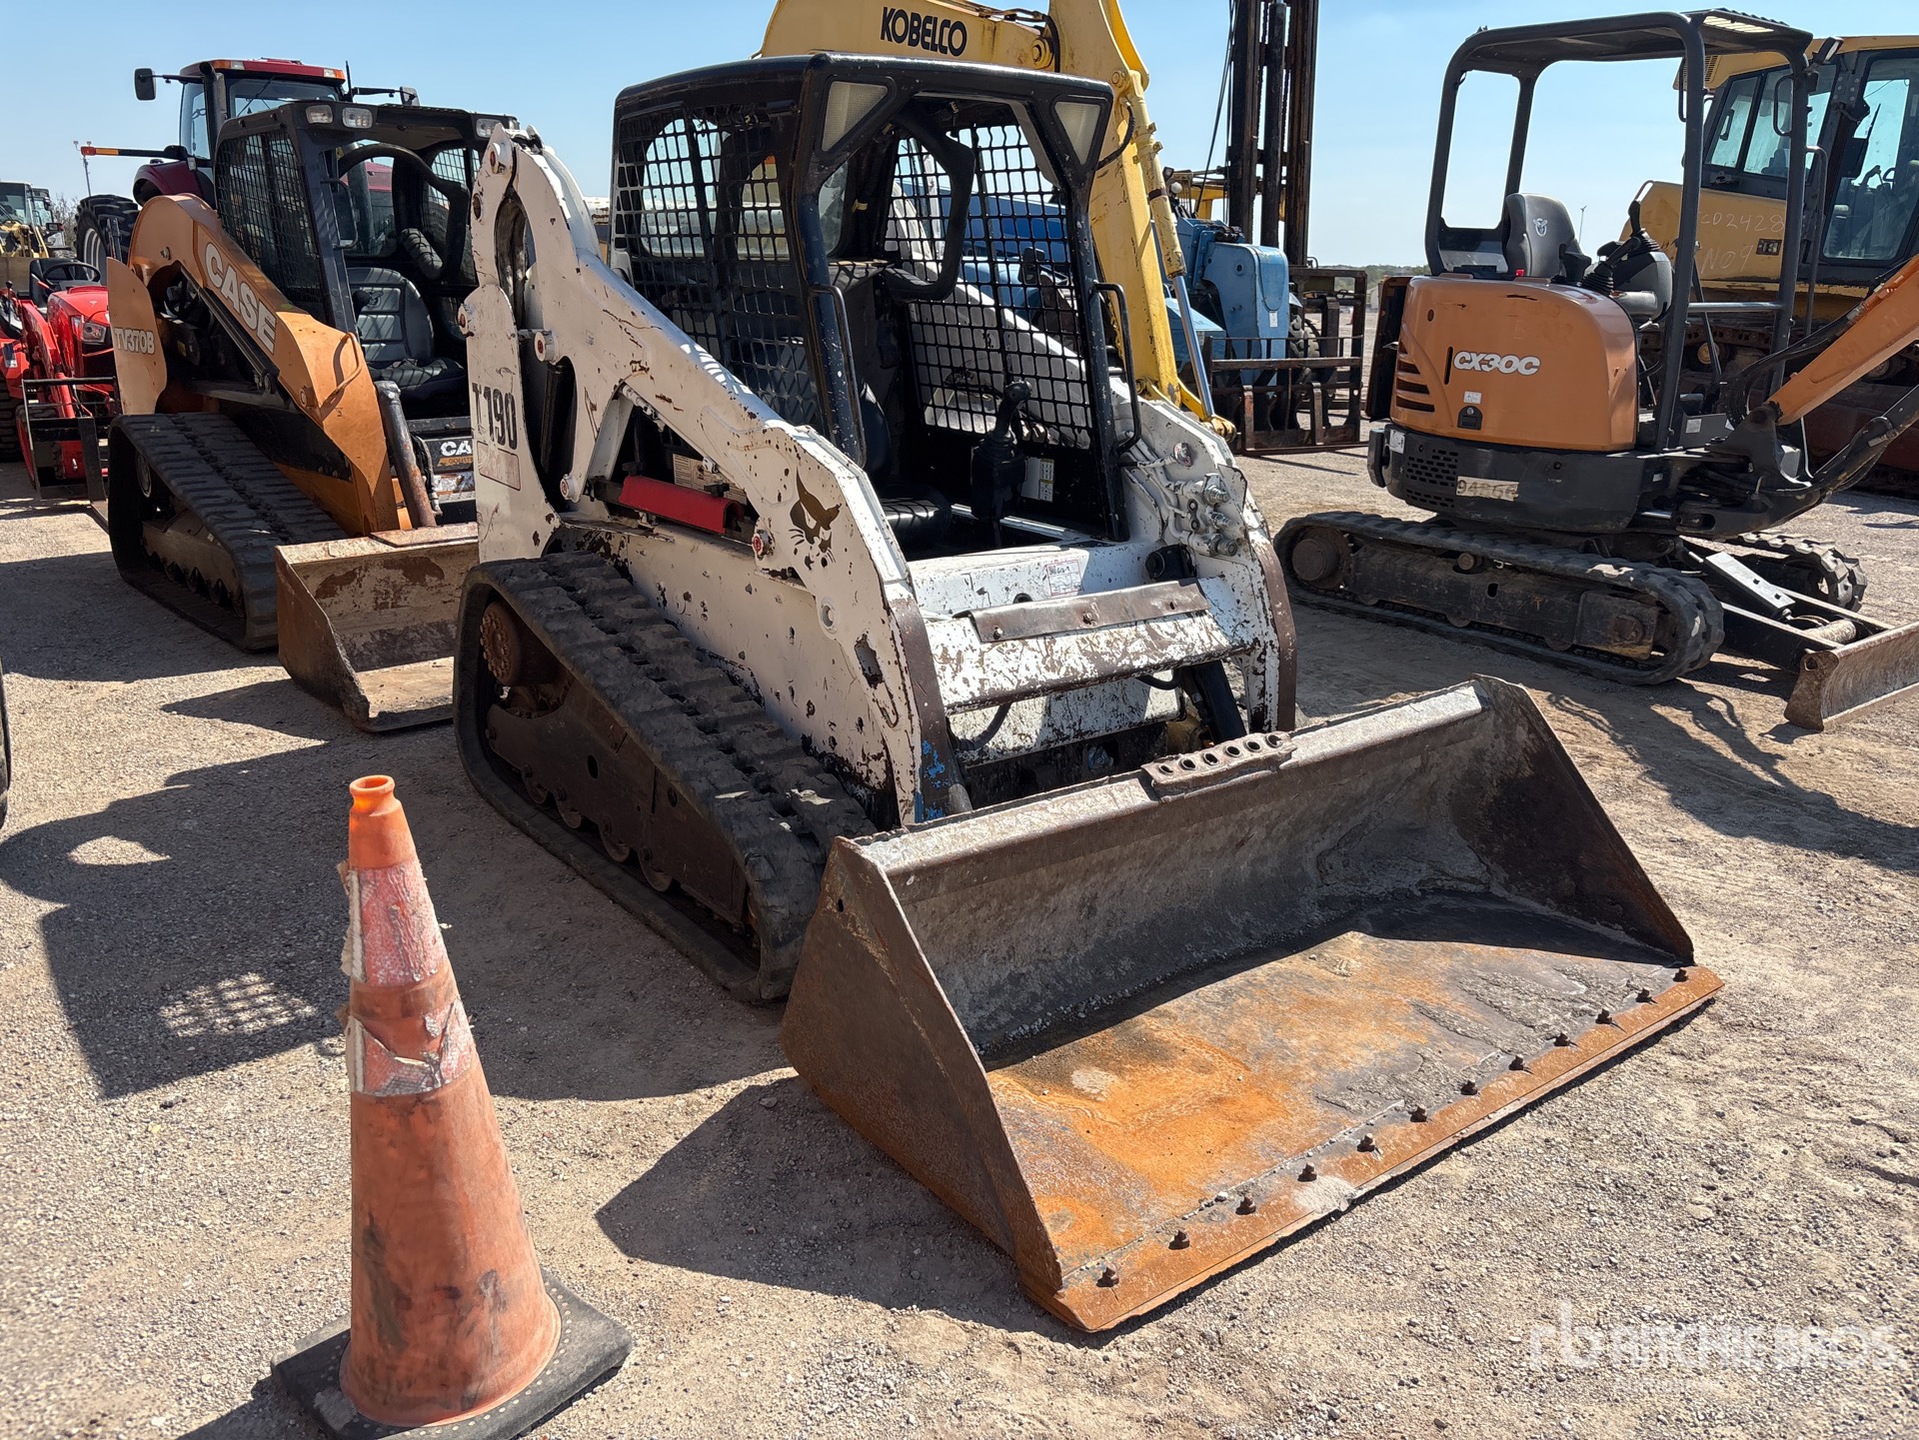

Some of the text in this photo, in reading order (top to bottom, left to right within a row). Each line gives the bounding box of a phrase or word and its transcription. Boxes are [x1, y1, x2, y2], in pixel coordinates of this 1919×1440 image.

[880, 6, 967, 57] KOBELCO
[205, 241, 277, 355] CASE
[114, 327, 156, 355] TV370B
[1453, 350, 1541, 376] CX30C
[471, 382, 518, 450] T190
[440, 440, 473, 457] CA
